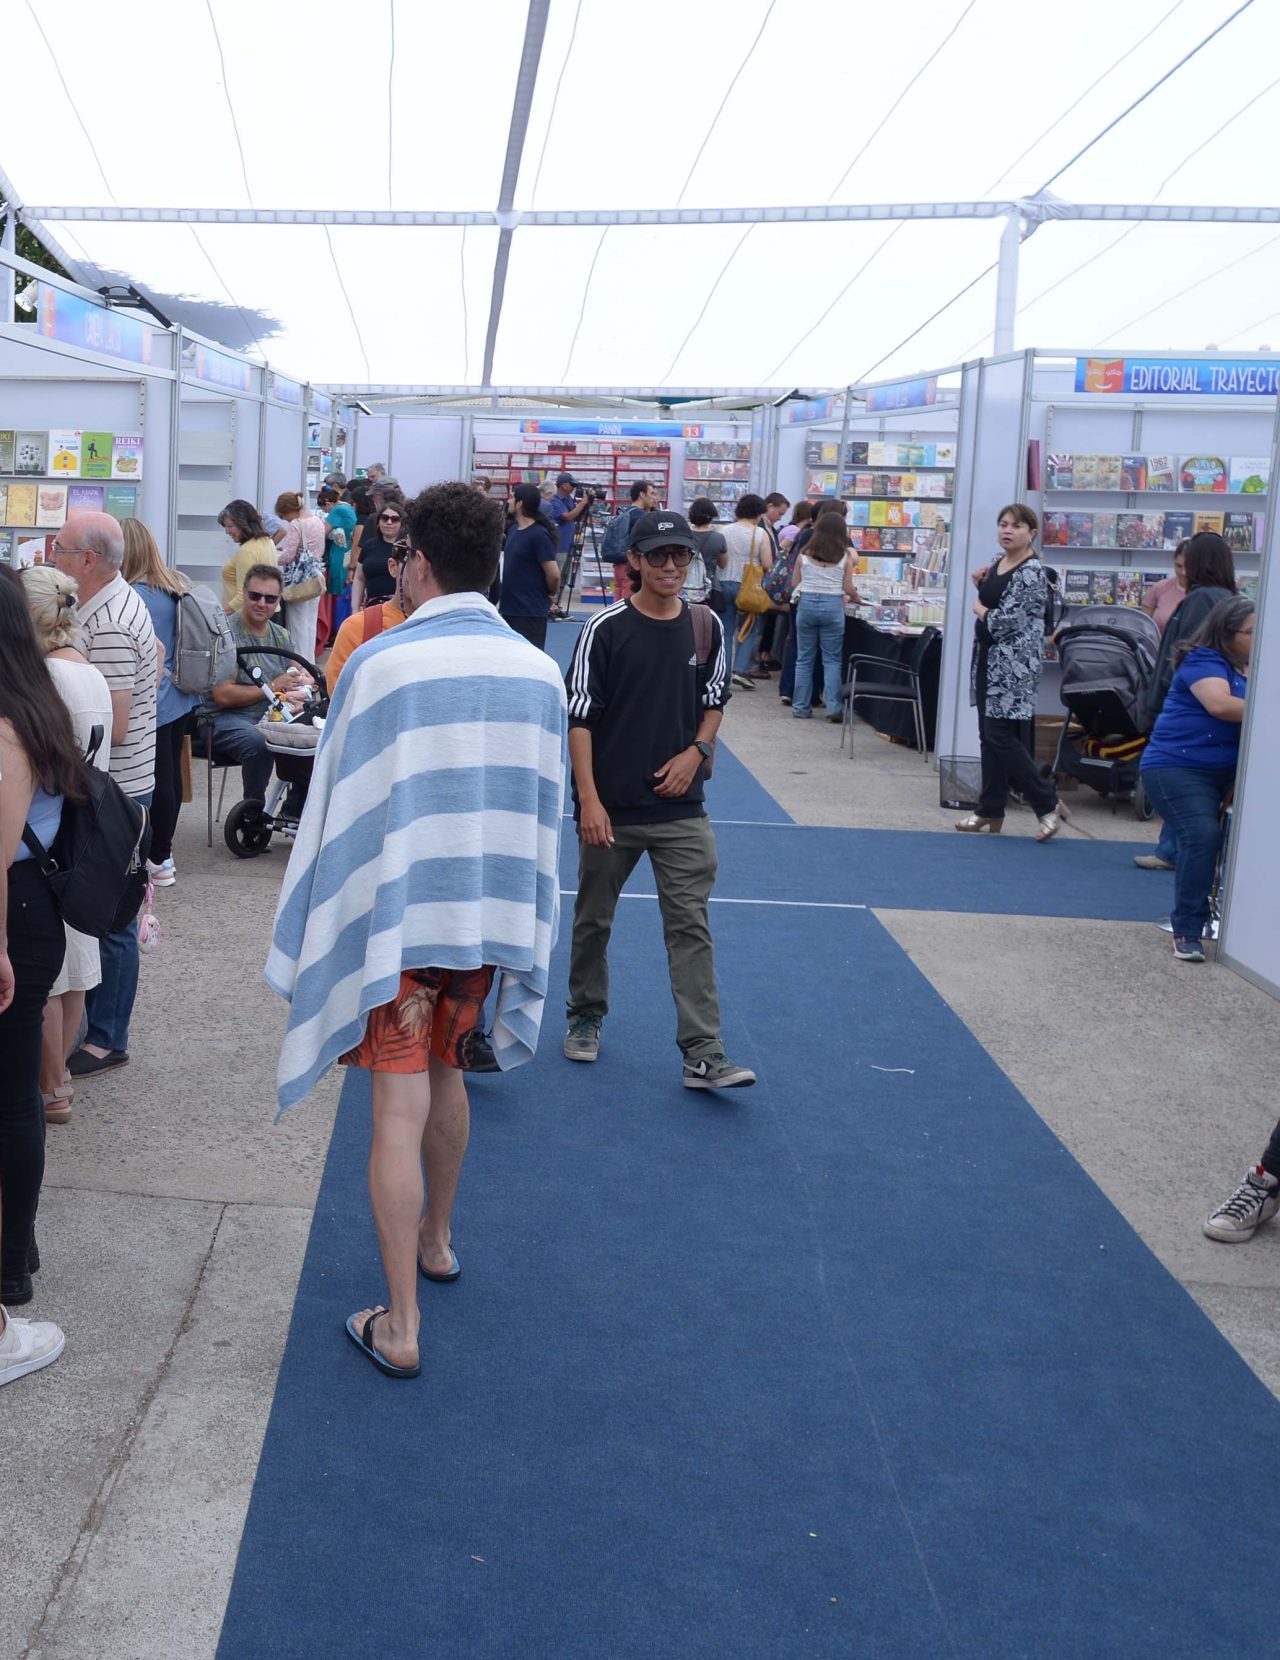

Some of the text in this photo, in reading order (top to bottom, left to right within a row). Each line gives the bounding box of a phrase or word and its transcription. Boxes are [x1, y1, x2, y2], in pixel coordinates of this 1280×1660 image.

[1130, 365, 1202, 392] EDITORIAL
[598, 423, 622, 435] PANINI
[686, 426, 701, 438] 13
[115, 437, 141, 446] REIKI
